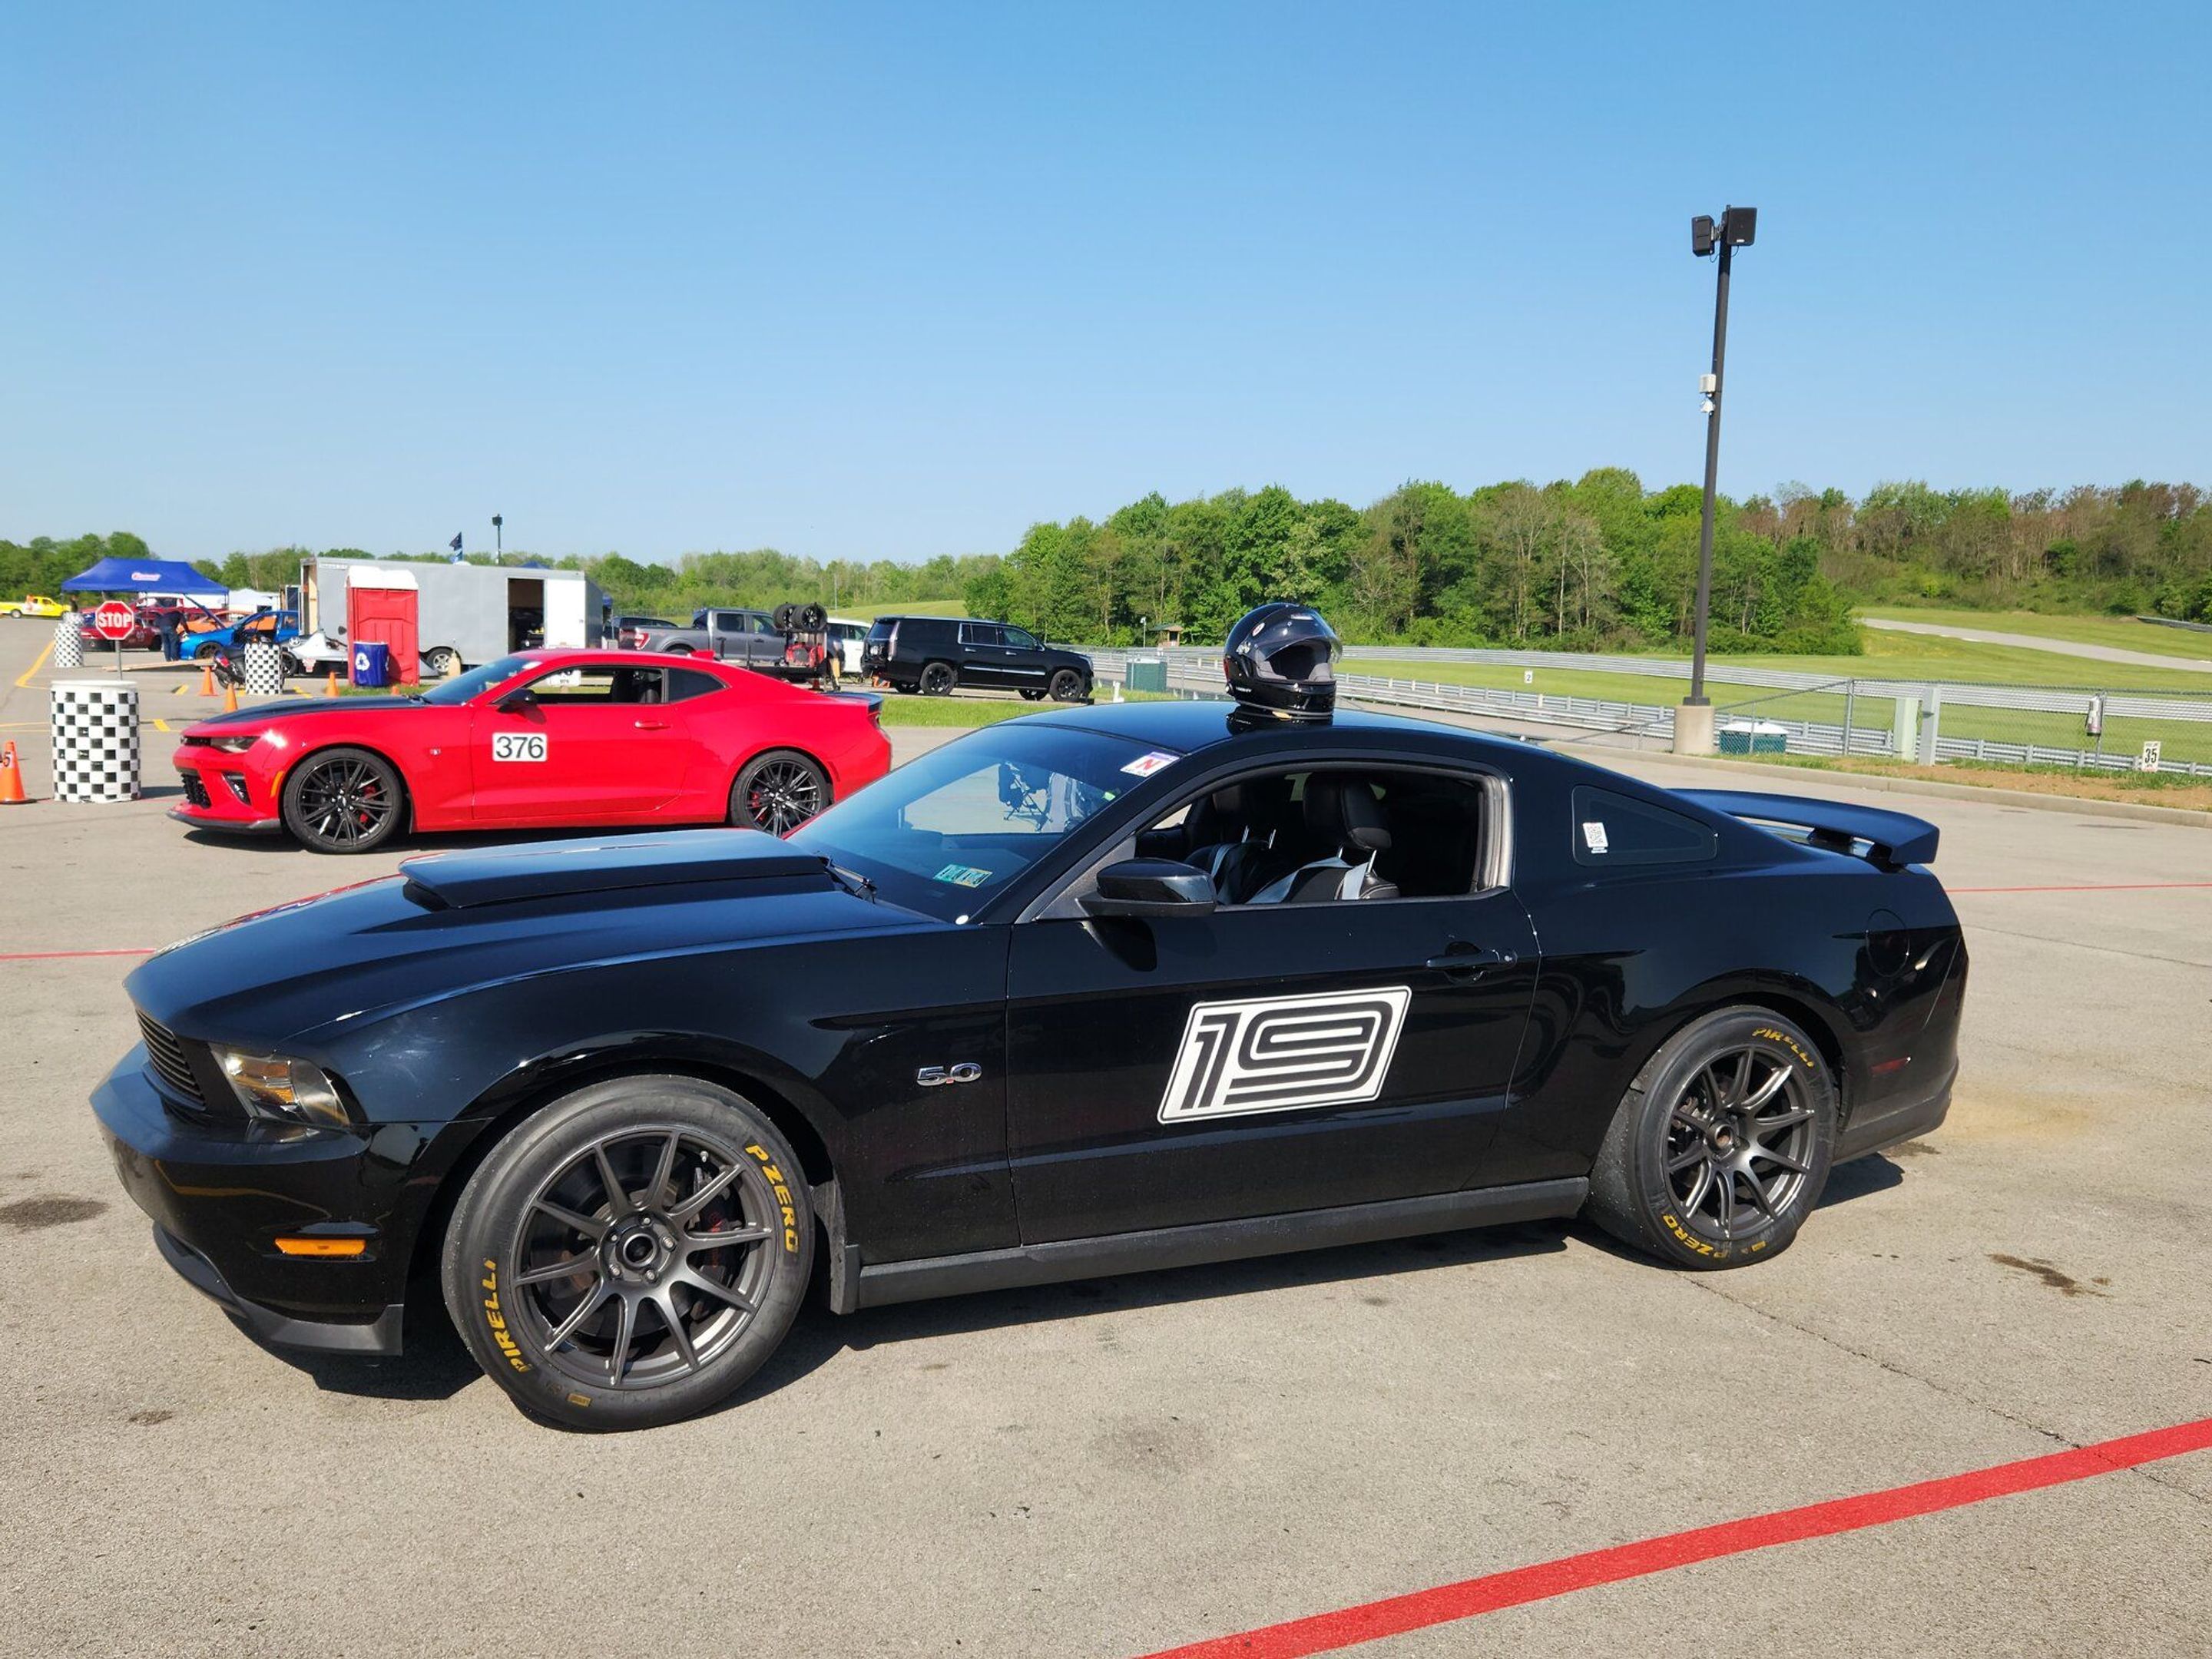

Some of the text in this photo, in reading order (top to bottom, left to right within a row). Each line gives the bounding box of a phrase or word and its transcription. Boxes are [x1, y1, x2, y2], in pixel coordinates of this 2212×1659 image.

[98, 611, 131, 628] STOP
[496, 736, 544, 759] 376
[2144, 747, 2157, 763] 35
[1181, 1001, 1393, 1111] 19
[916, 1062, 982, 1086] 5.0
[482, 1257, 531, 1373] PIRELLI
